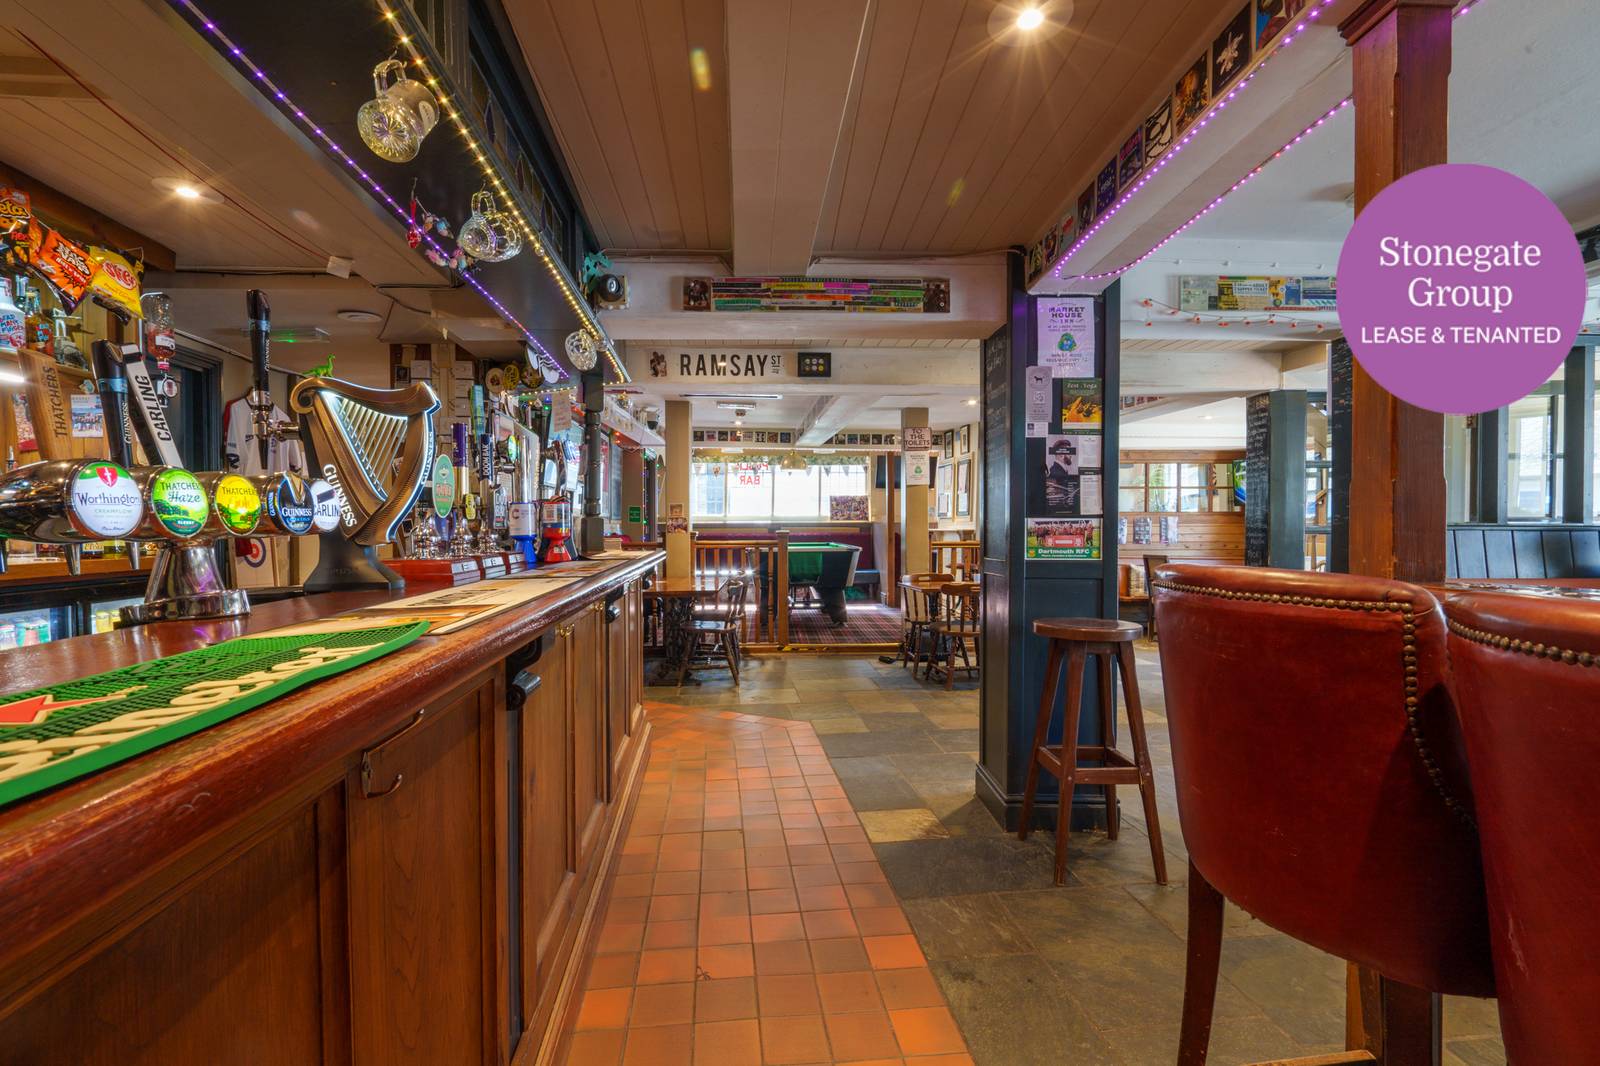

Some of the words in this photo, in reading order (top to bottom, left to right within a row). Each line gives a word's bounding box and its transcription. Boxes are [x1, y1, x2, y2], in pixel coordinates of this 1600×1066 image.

[680, 354, 768, 377] RAMSAY
[771, 355, 782, 366] ST
[42, 365, 69, 438] THATCHERS
[122, 401, 132, 444] GUINNESS
[134, 374, 170, 442] CARLING
[168, 490, 201, 503] Haze
[282, 507, 313, 517] GUINNESS
[323, 463, 357, 527] GUINNESS
